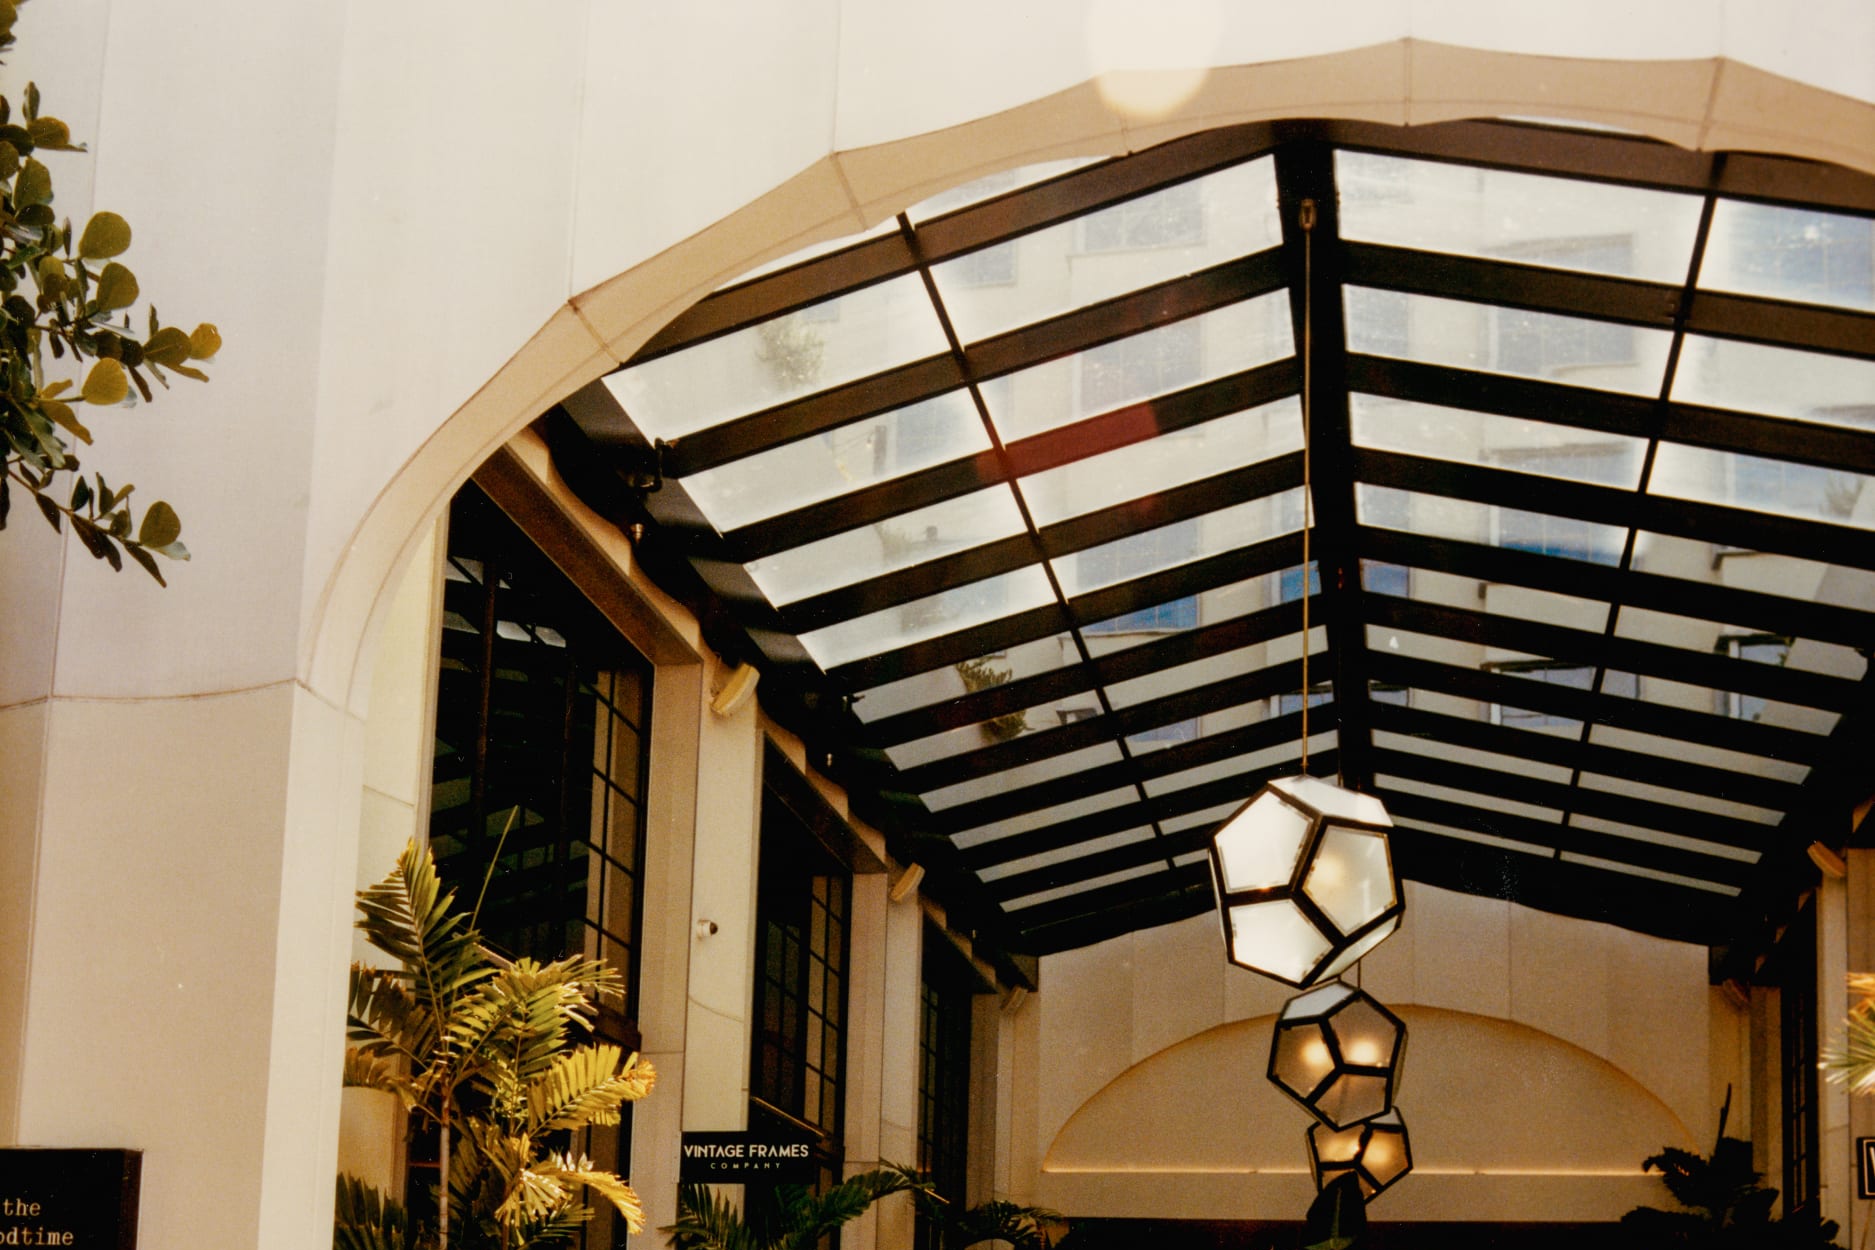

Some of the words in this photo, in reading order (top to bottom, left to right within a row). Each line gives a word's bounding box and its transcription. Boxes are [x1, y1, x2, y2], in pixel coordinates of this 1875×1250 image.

[684, 1145, 744, 1158] VINTAGE
[749, 1144, 809, 1157] FRAMES
[3, 1198, 41, 1216] the
